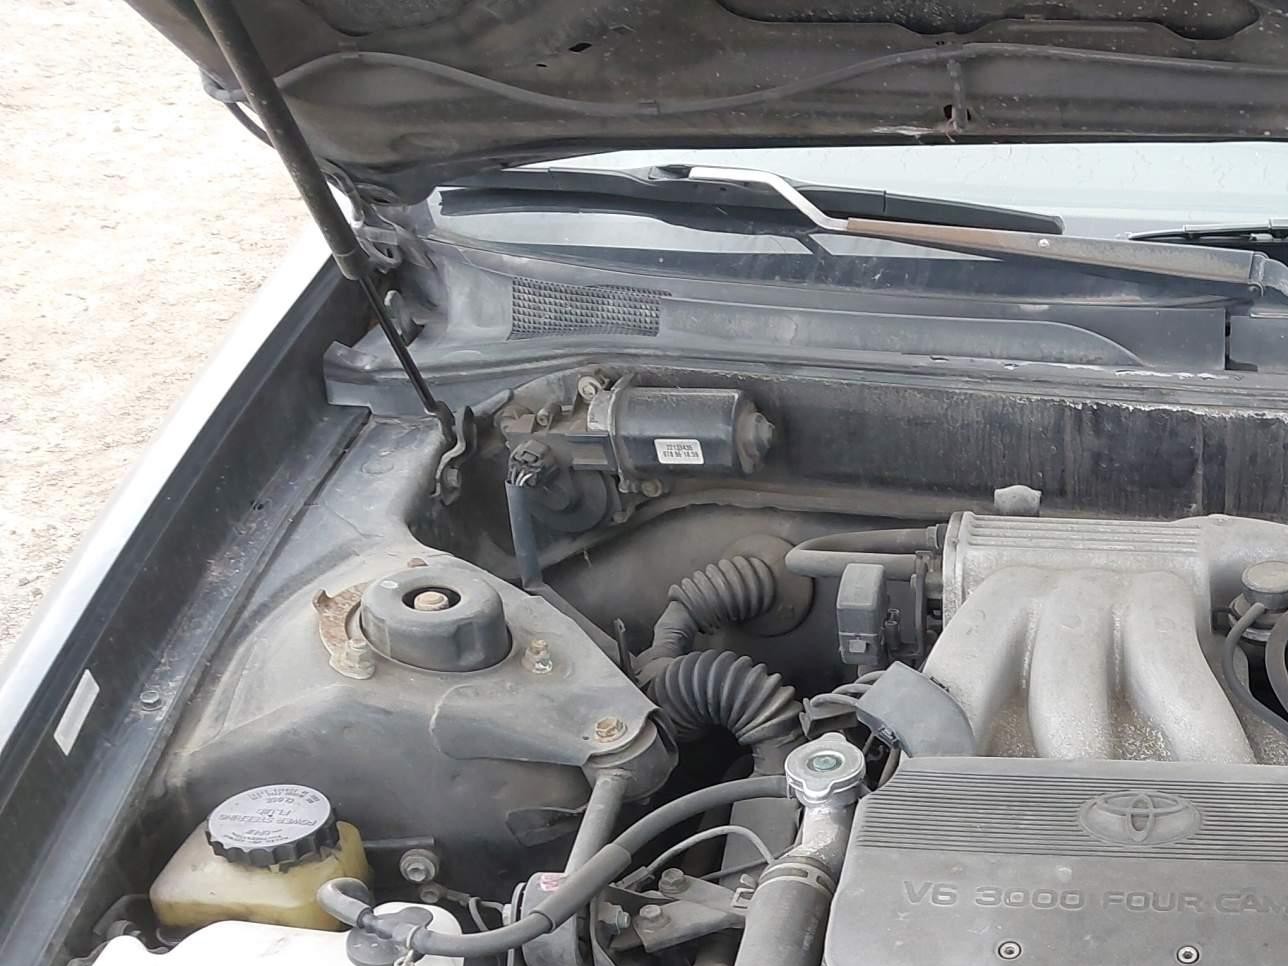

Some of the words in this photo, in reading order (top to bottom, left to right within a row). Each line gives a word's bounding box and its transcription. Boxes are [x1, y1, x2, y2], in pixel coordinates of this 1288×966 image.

[902, 879, 958, 908] V6
[975, 885, 1085, 911] 3000
[1101, 889, 1202, 913] FOUR
